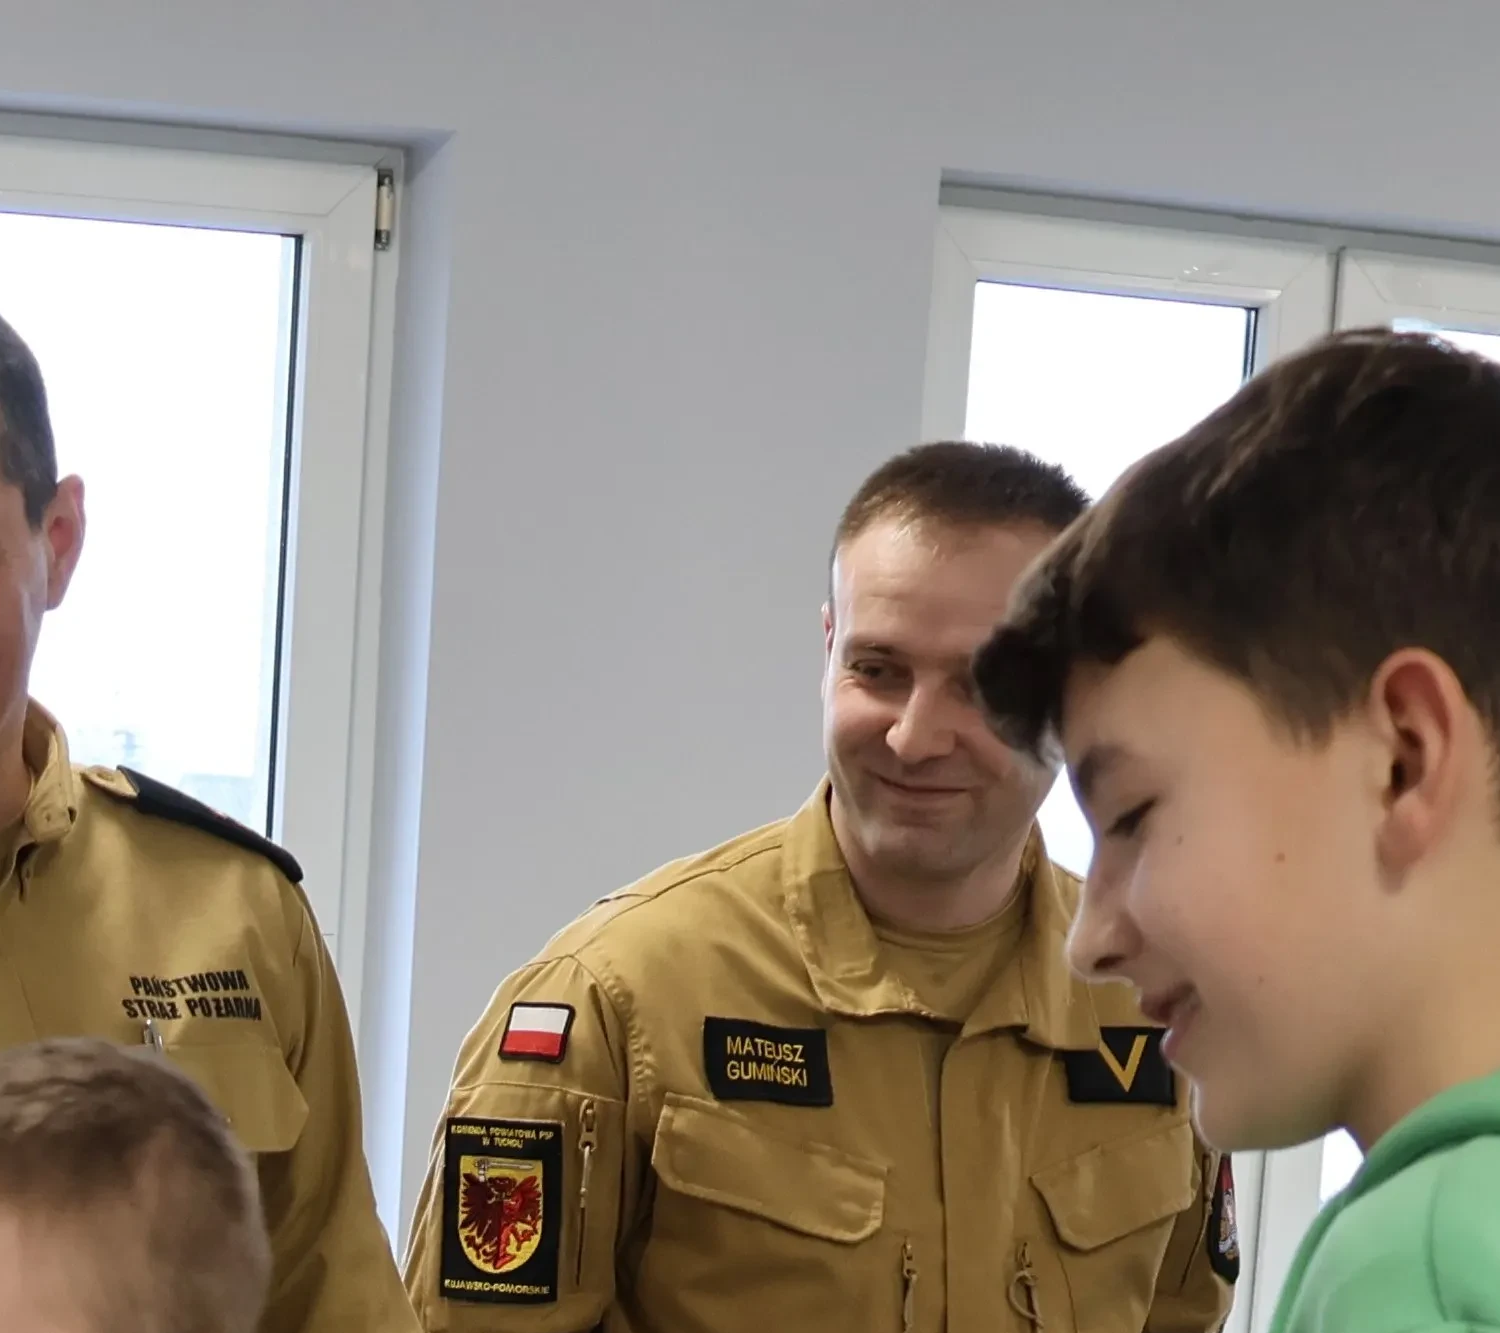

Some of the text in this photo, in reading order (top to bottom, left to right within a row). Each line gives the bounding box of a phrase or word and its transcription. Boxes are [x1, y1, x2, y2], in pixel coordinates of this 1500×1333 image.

[129, 968, 250, 998] PAŃSTWOWA
[726, 1036, 805, 1063] MATEUSZ
[726, 1060, 808, 1088] GUMIŃSKI
[482, 1137, 490, 1146] W
[443, 1278, 551, 1295] KUJAWSKO-POMORSKIE
